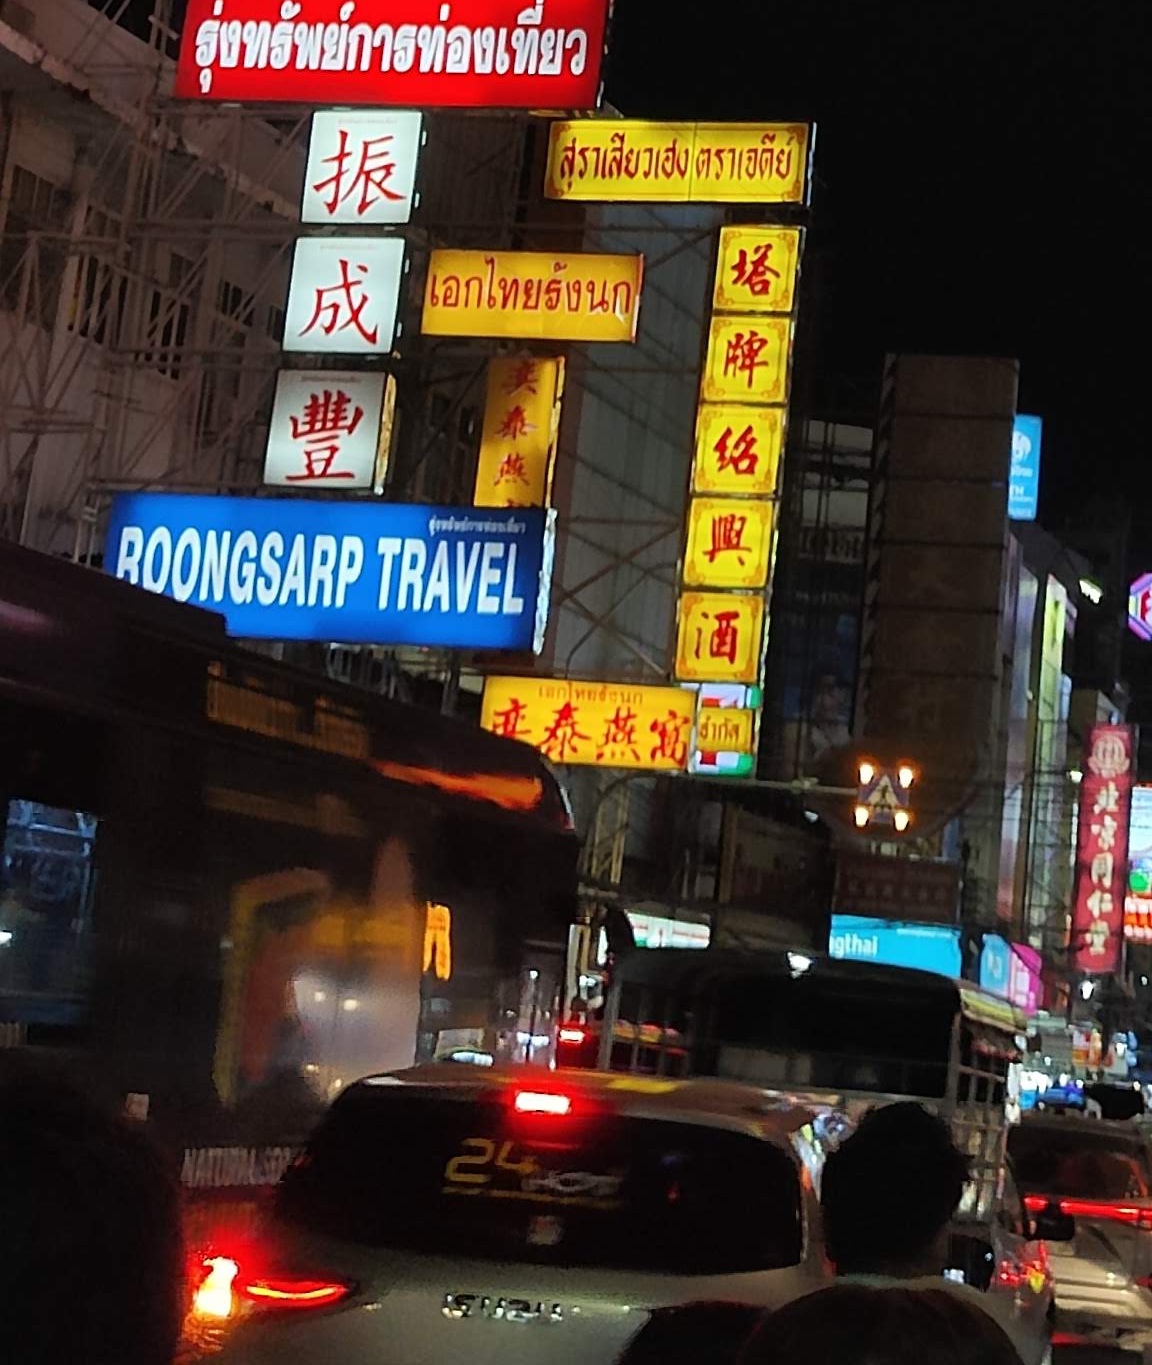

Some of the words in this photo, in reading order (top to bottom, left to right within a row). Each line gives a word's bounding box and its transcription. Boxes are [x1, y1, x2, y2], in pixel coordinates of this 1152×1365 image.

[696, 133, 794, 181] ตราเจดีย์
[429, 256, 633, 315] เอกไทยรังนก
[116, 526, 364, 606] ROONGSARP
[377, 536, 525, 615] TRAVEL
